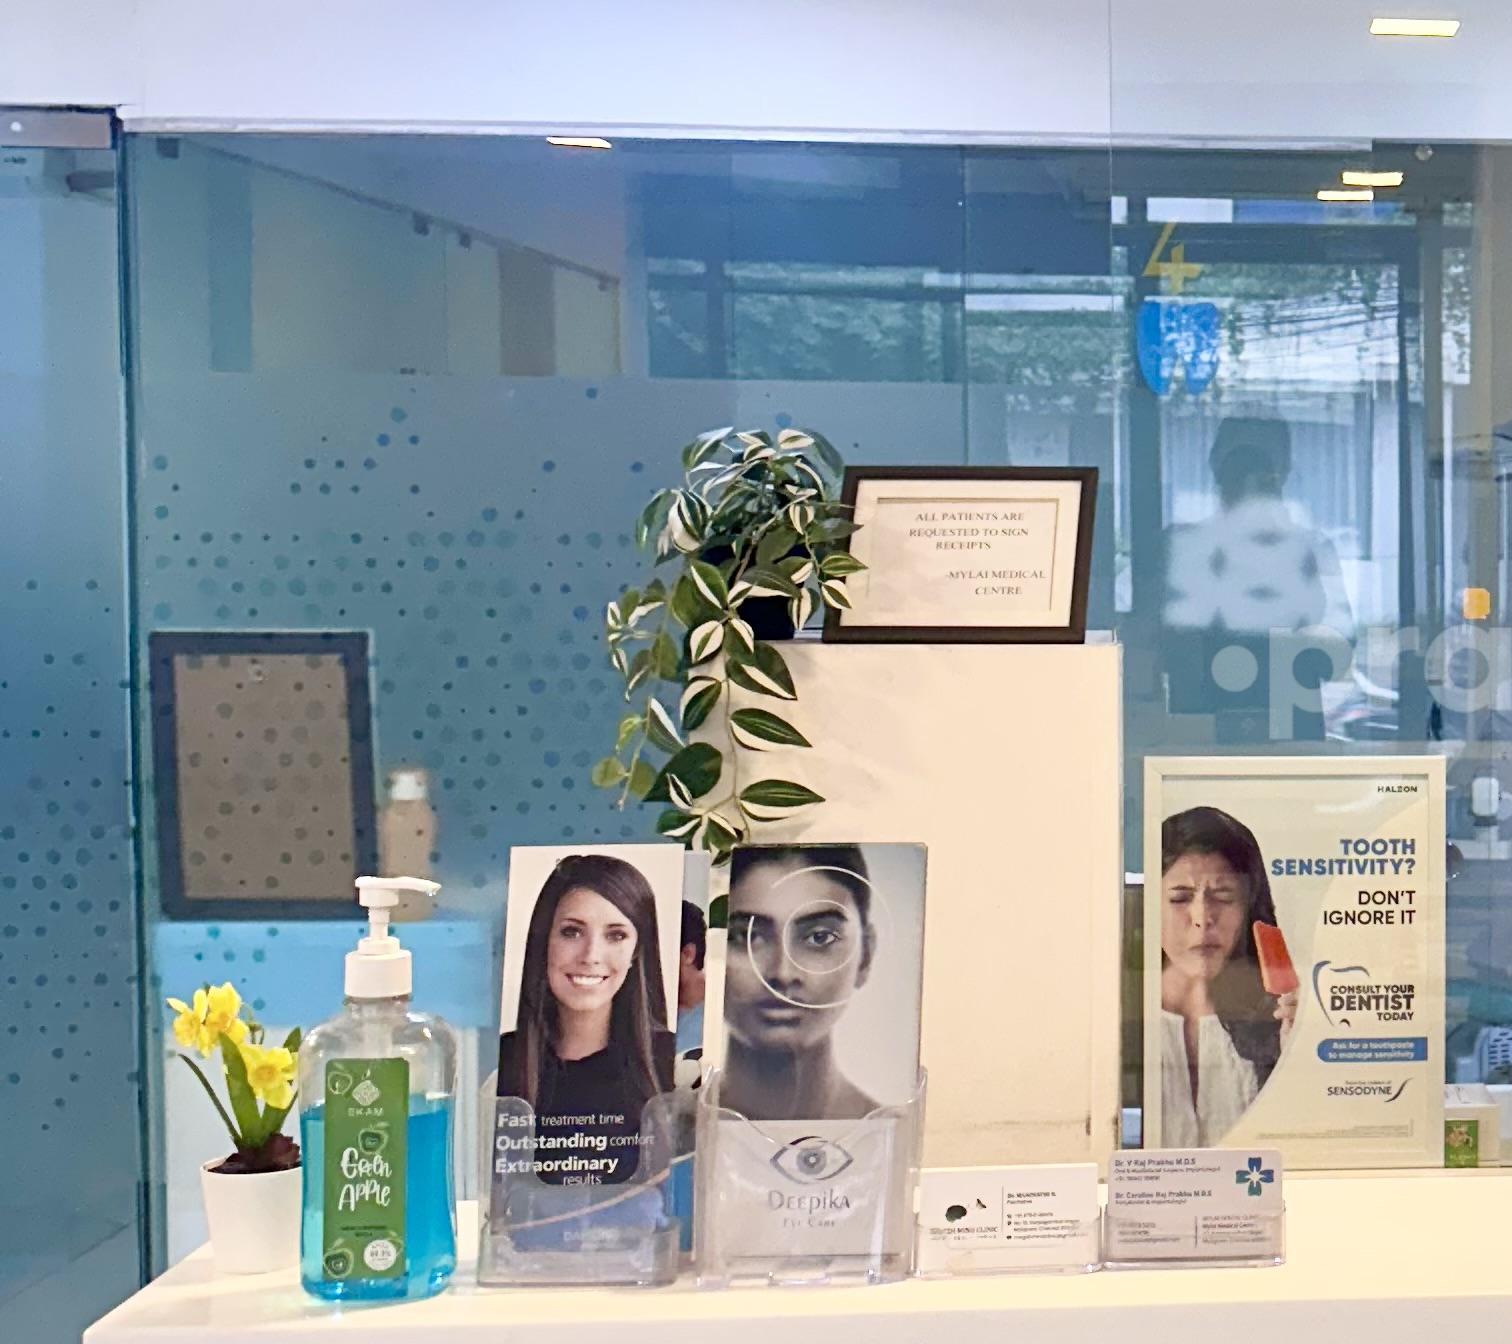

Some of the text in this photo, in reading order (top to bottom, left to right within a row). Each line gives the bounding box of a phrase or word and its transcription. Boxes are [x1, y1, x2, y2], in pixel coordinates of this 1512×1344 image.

[916, 512, 1025, 522] ALL PATIENTS ARE
[909, 528, 1029, 538] REQUESTED TO SIGN
[935, 541, 992, 551] RECEIPTS
[991, 569, 1047, 579] MEDICAL
[974, 586, 1023, 595] CENTRE
[1340, 838, 1416, 856] TOOTH
[1271, 858, 1416, 876] SENSITIVITY?
[1358, 890, 1416, 905] DON'T
[1323, 909, 1416, 925] IGNORE IT
[1330, 984, 1415, 995] CONSULT YOUR
[1330, 994, 1415, 1011] DENTIST
[1376, 1012, 1414, 1021] TODAY
[1349, 1041, 1360, 1050] for
[1369, 1041, 1415, 1051] toothpaste
[1327, 1086, 1393, 1096] SENSODYNE
[497, 1113, 625, 1128] Fast treatment time
[496, 1132, 656, 1151] Outstanding comfort
[495, 1156, 619, 1173] Extraordinary
[563, 1172, 603, 1186] results
